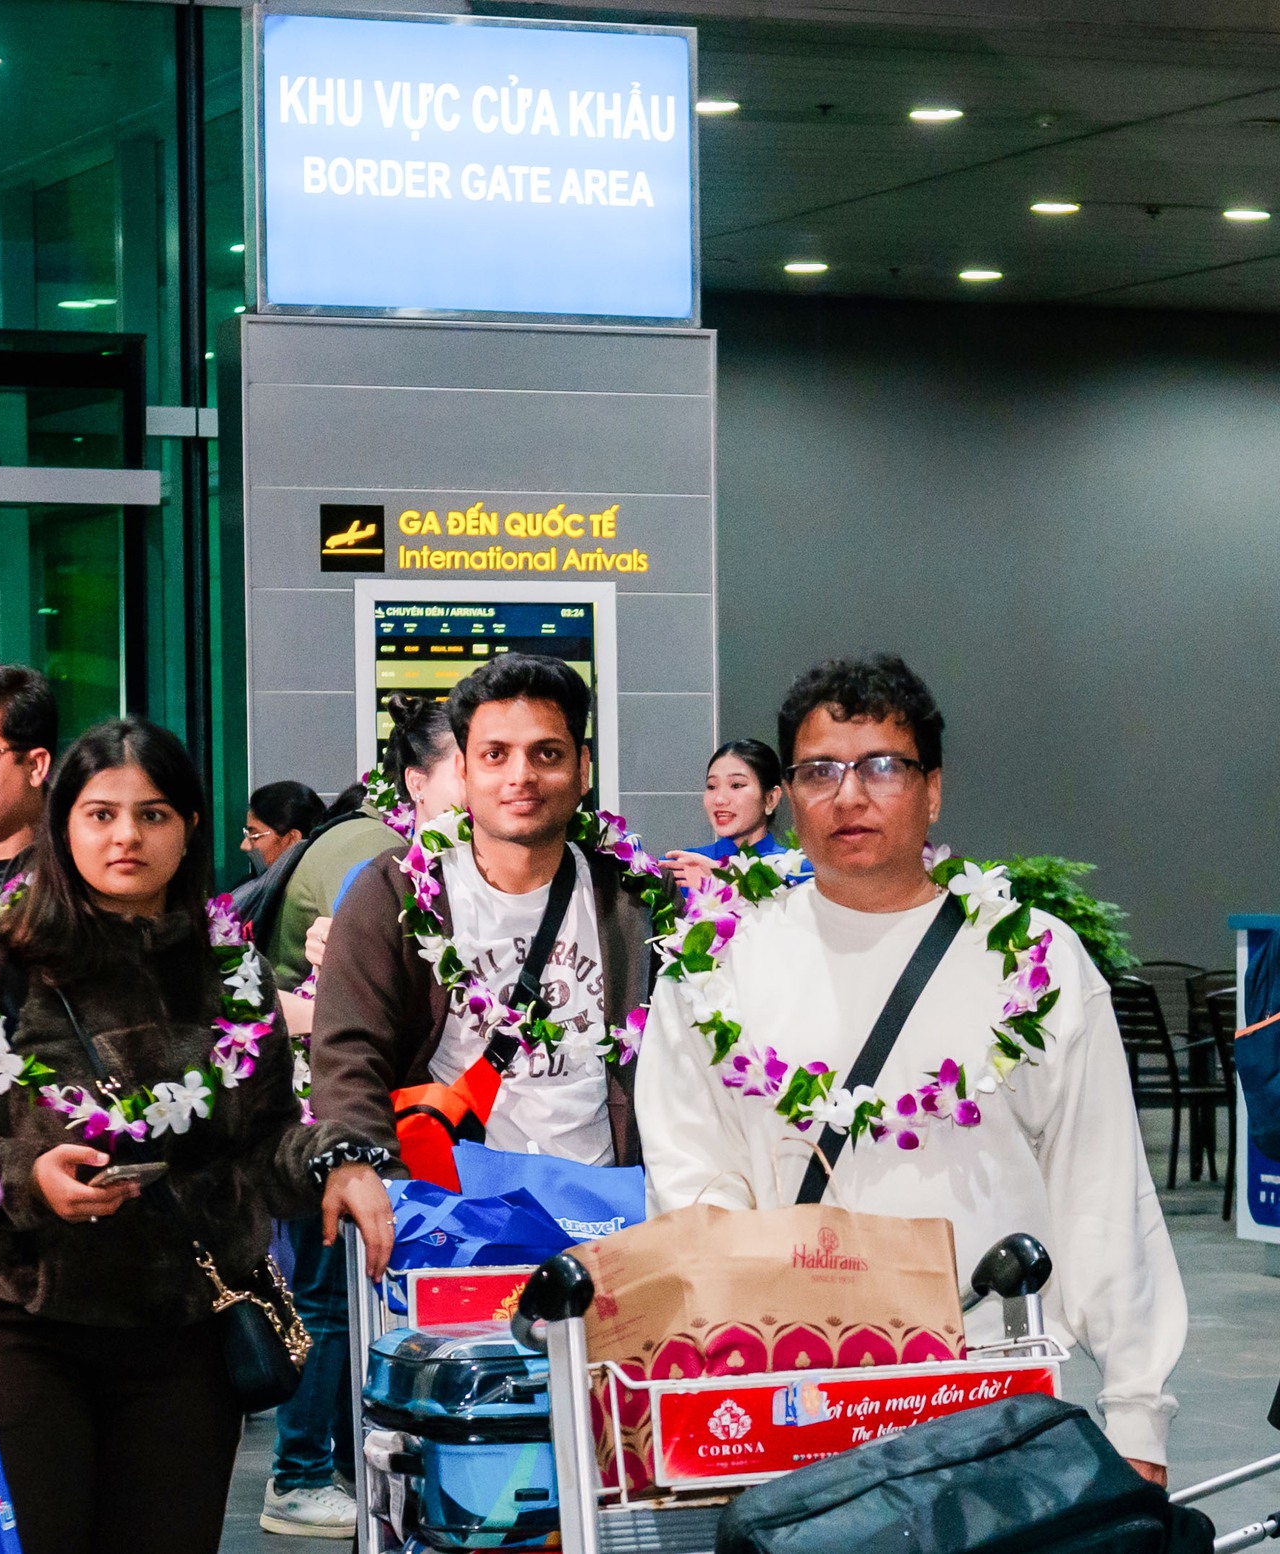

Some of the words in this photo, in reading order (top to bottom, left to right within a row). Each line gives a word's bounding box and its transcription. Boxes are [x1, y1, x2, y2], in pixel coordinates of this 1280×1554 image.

[279, 75, 362, 127] KHU
[374, 79, 461, 142] VỰC
[472, 74, 560, 137] CỬA
[569, 81, 676, 142] KHẨU
[303, 155, 452, 200] BORDER
[460, 163, 552, 204] GATE
[559, 167, 655, 208] AREA
[398, 509, 442, 536] GA
[446, 502, 499, 536] ĐẾN
[504, 503, 585, 538] QUỐC
[589, 504, 620, 538] TẾ
[398, 545, 557, 572] International
[562, 547, 649, 573] Arrivals
[450, 608, 495, 618] ARRIVALS
[557, 1216, 624, 1235] travel
[846, 1396, 881, 1421] vận
[885, 1392, 926, 1416] may
[931, 1383, 964, 1406] đón
[851, 1425, 874, 1443] The
[697, 1441, 766, 1458] CORONA
